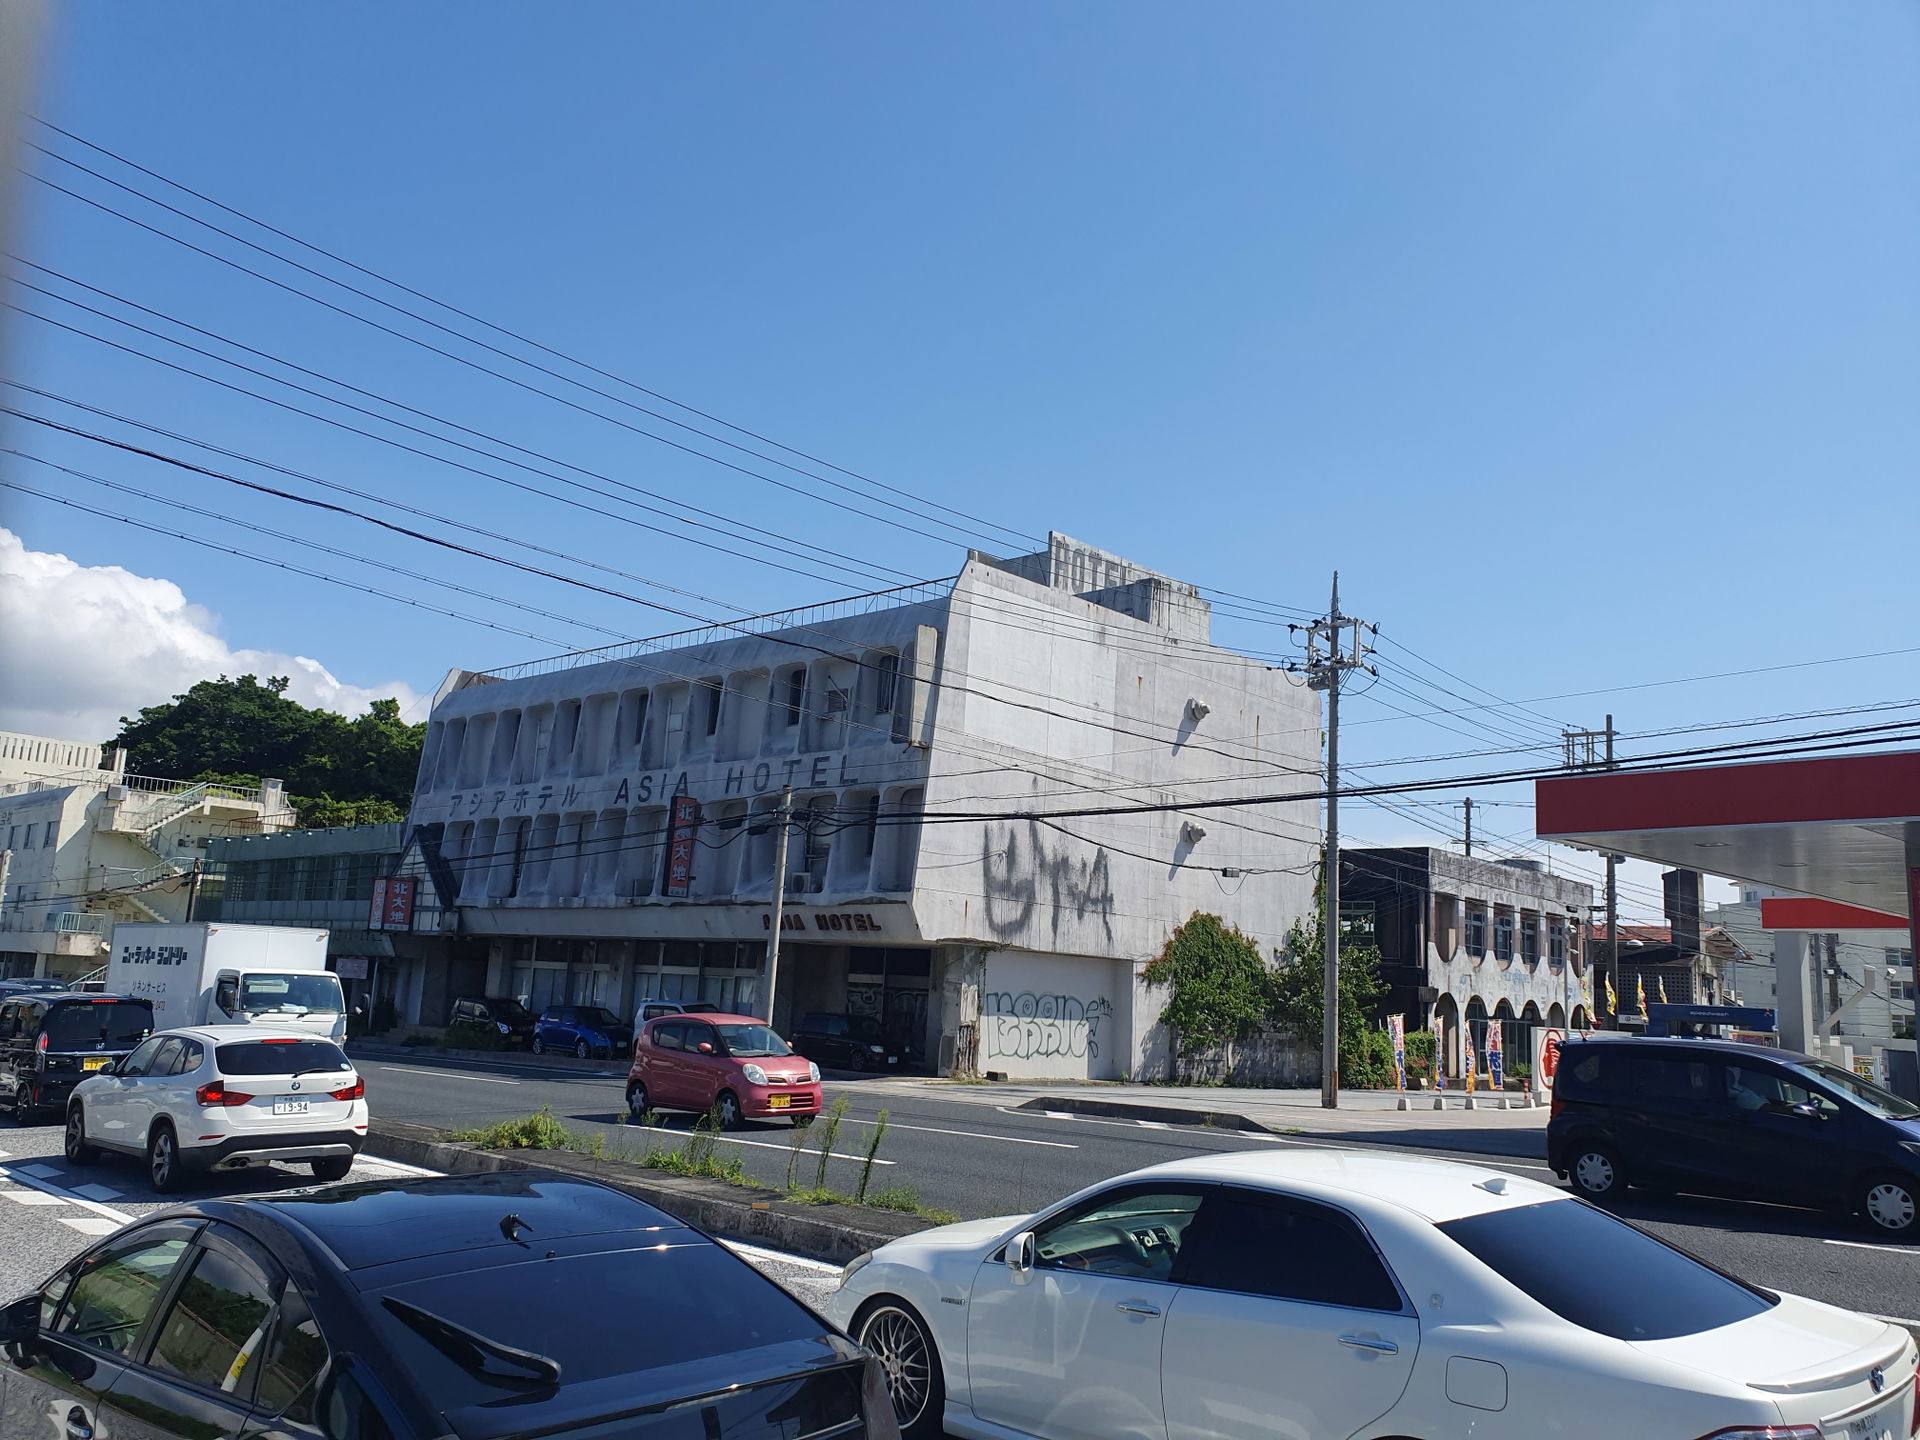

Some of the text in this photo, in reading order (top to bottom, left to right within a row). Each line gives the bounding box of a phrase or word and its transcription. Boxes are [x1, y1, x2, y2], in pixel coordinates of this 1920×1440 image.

[613, 755, 858, 804] ASIA HOTEL
[449, 783, 579, 817] アジアホテル
[391, 882, 408, 923] 北大地
[814, 913, 882, 931] HOTEL
[283, 1102, 308, 1112] 19-94
